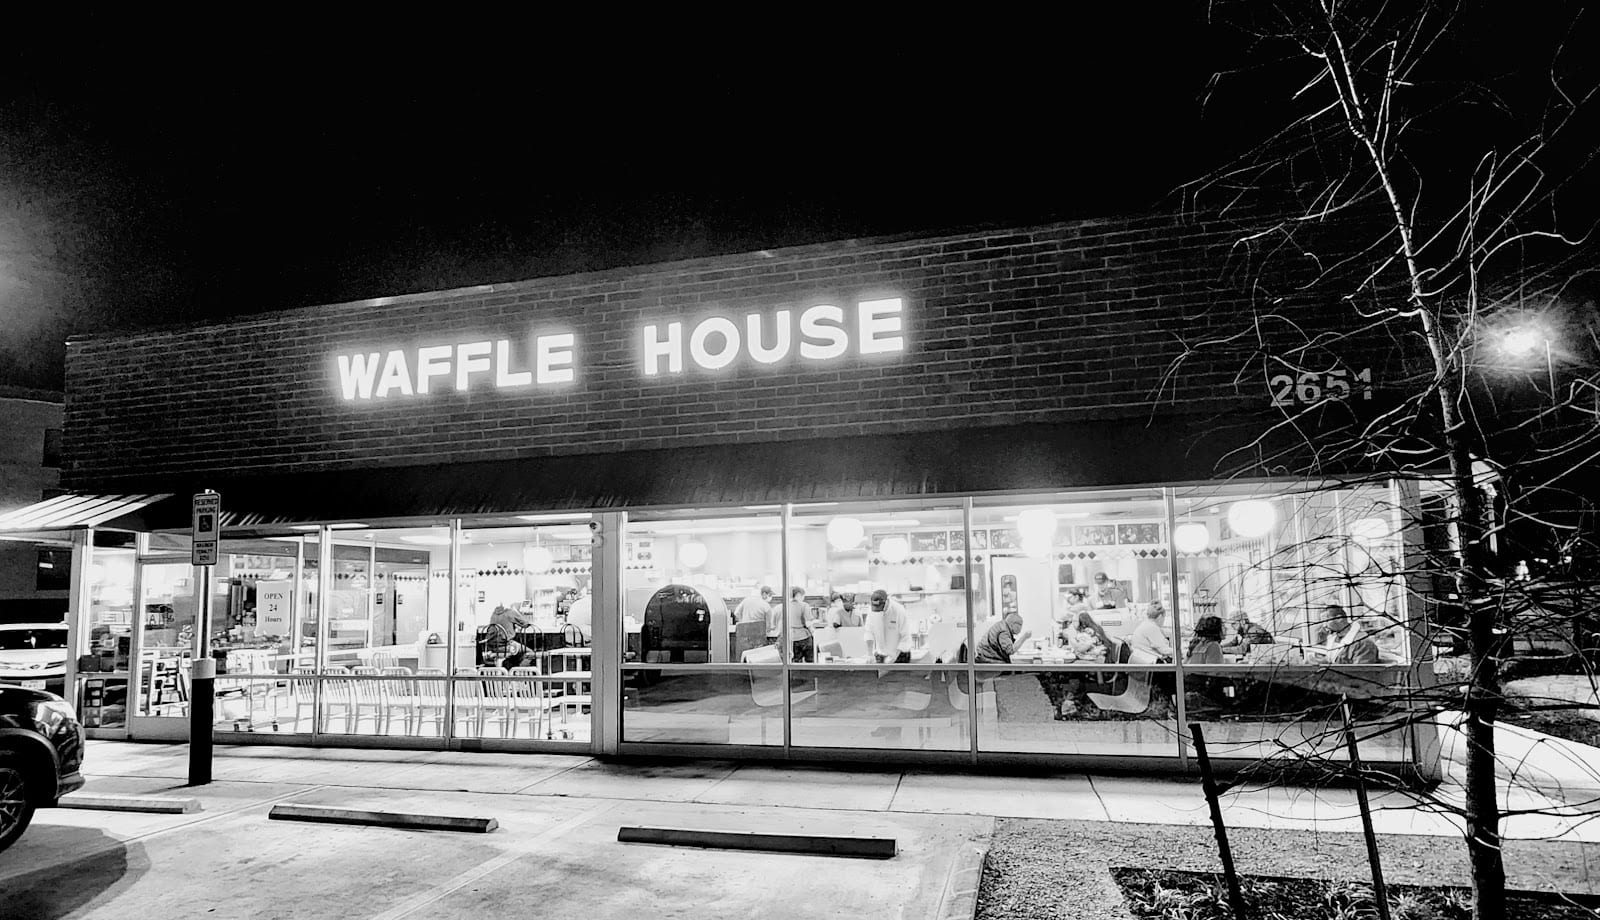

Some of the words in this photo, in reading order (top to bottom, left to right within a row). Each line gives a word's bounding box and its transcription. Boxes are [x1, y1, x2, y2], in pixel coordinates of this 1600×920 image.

[338, 333, 574, 400] WAFFLE
[643, 298, 904, 375] HOUSE
[1270, 367, 1372, 407] 2651
[264, 592, 284, 600] OPEN
[269, 603, 278, 612] 24
